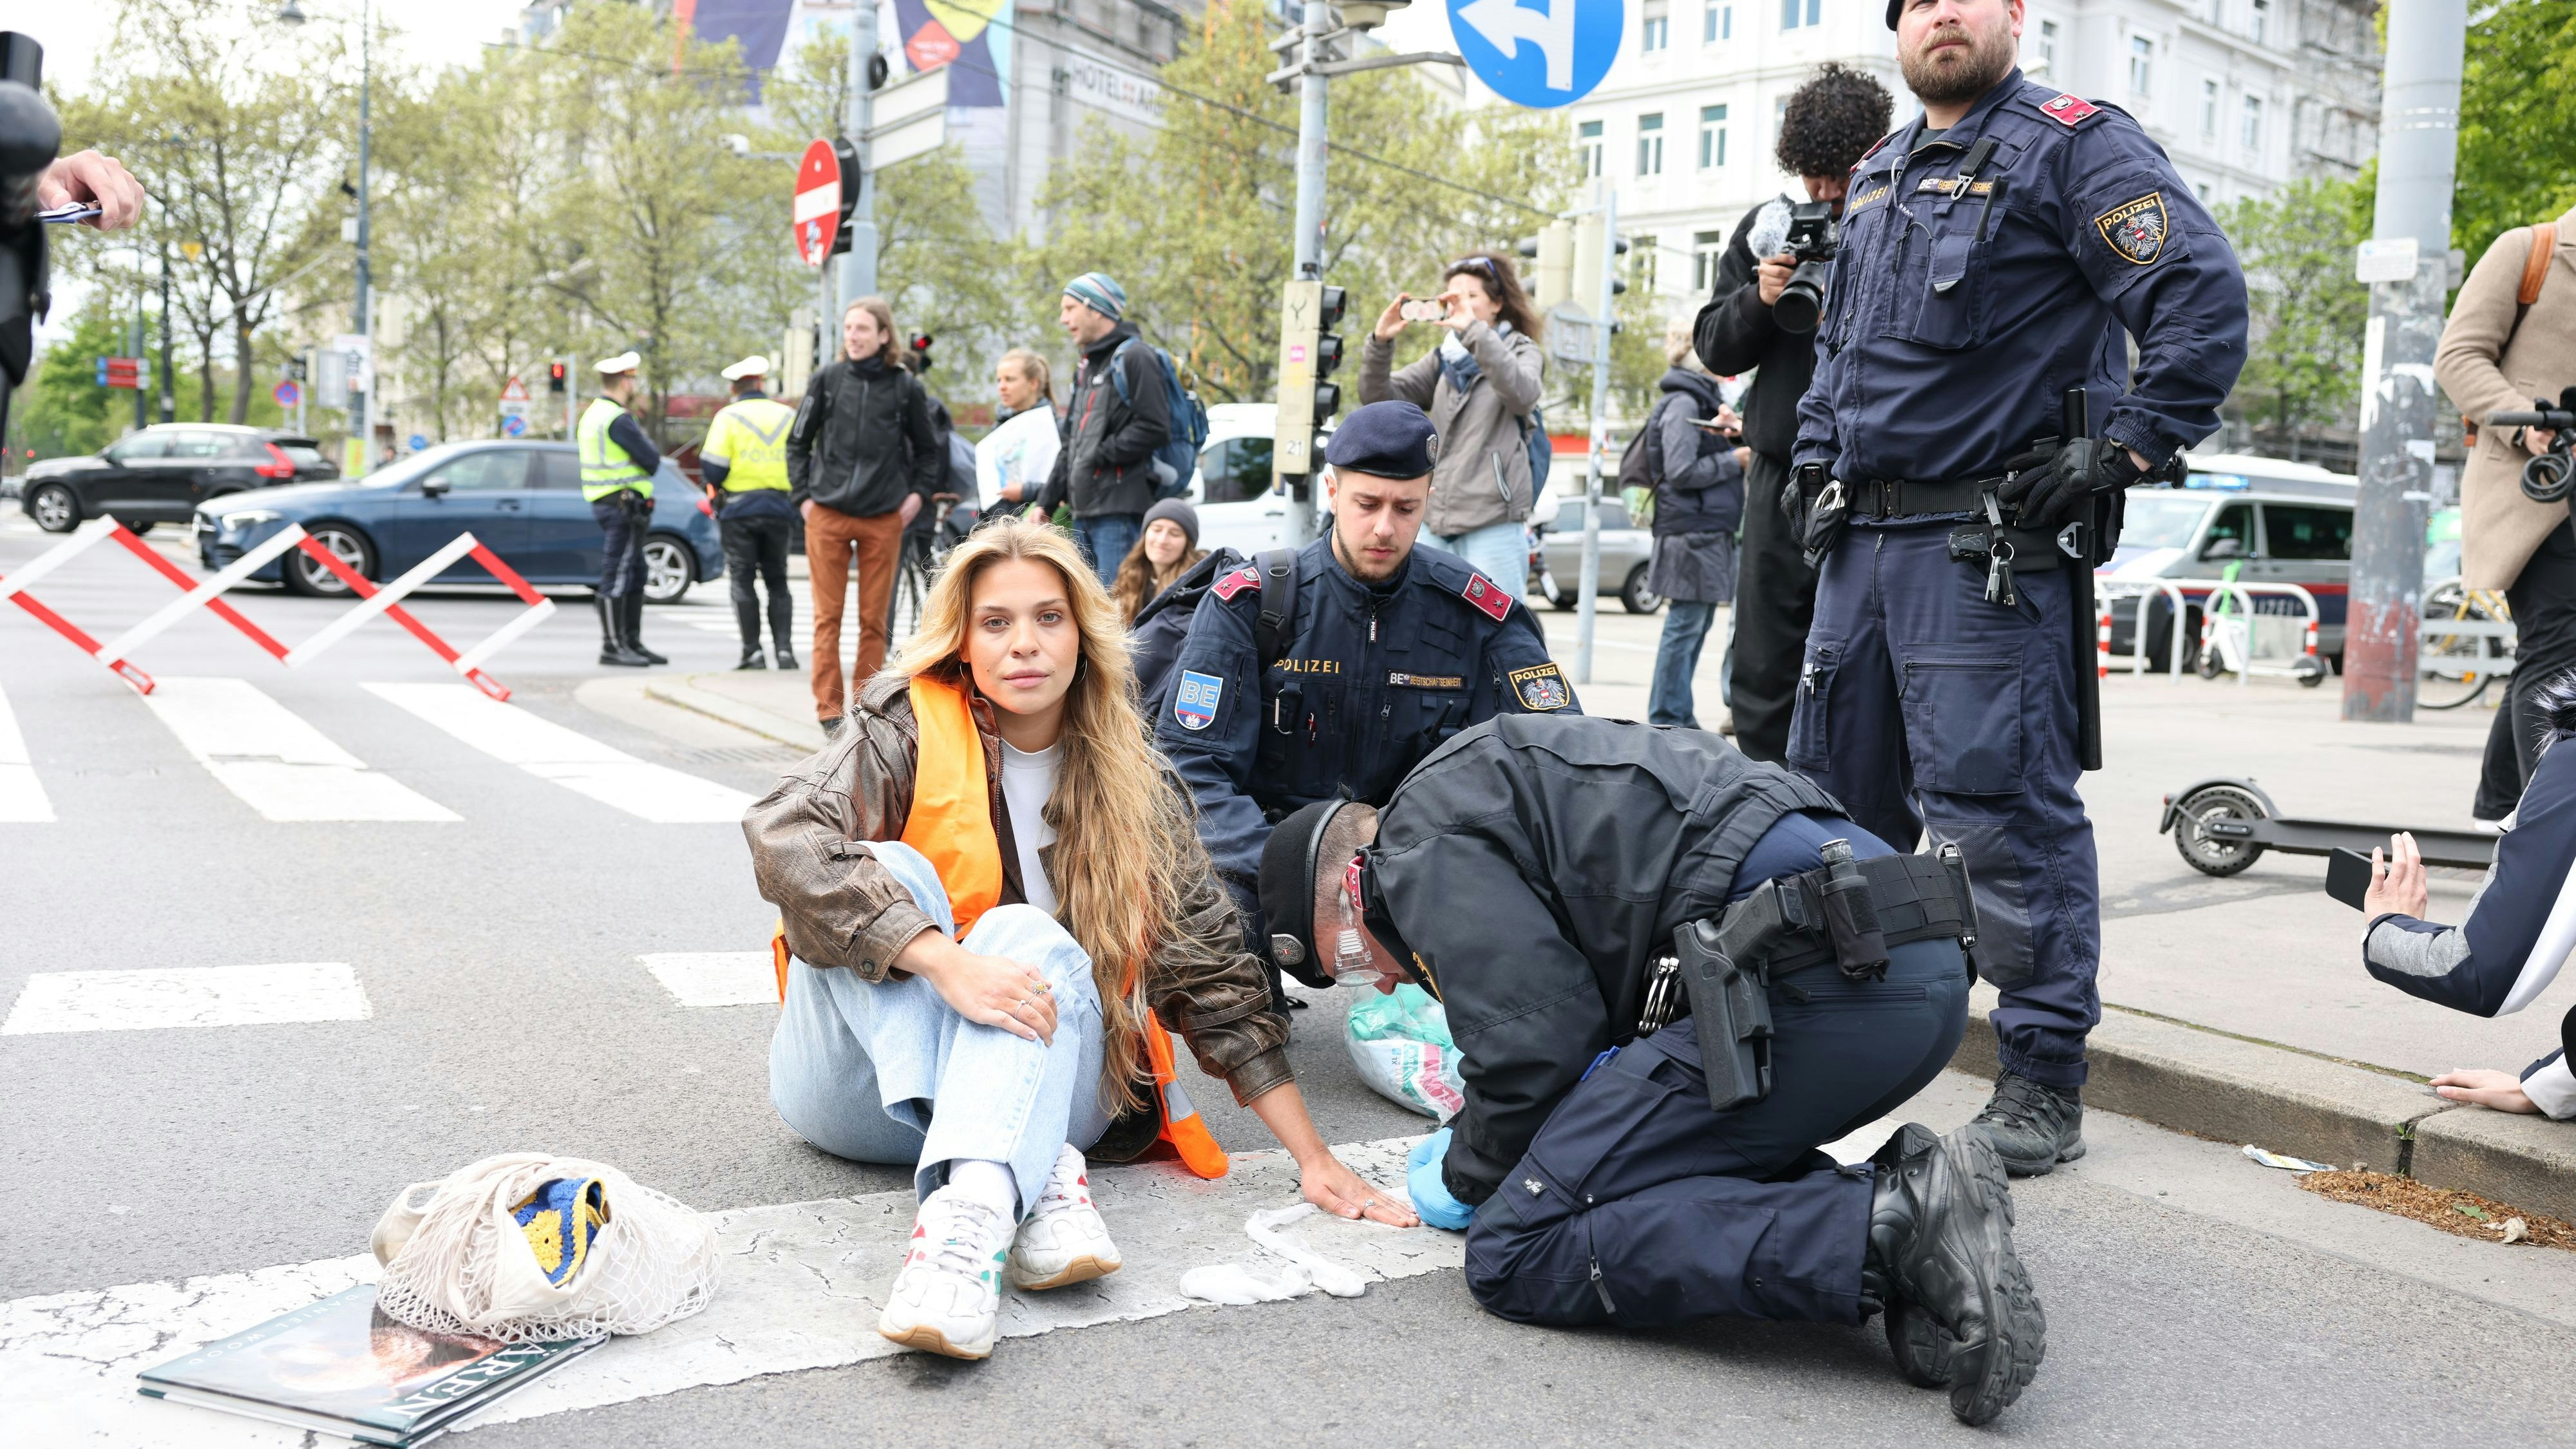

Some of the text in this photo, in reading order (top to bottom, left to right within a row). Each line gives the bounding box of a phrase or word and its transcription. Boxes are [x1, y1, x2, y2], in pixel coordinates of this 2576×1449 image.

[1072, 58, 1121, 102] HOTEL
[1919, 178, 1934, 189] BE
[1849, 185, 1889, 214] POLIZEI
[2102, 198, 2157, 231] POLIZEI
[1287, 440, 1304, 455] 21
[1273, 658, 1340, 674] POLIZEI
[1513, 666, 1558, 683] POLIZEI
[1390, 672, 1404, 685] BE
[1180, 679, 1218, 709] BE
[1391, 1056, 1397, 1065] XL
[188, 1293, 359, 1365] DANIEL WOOD
